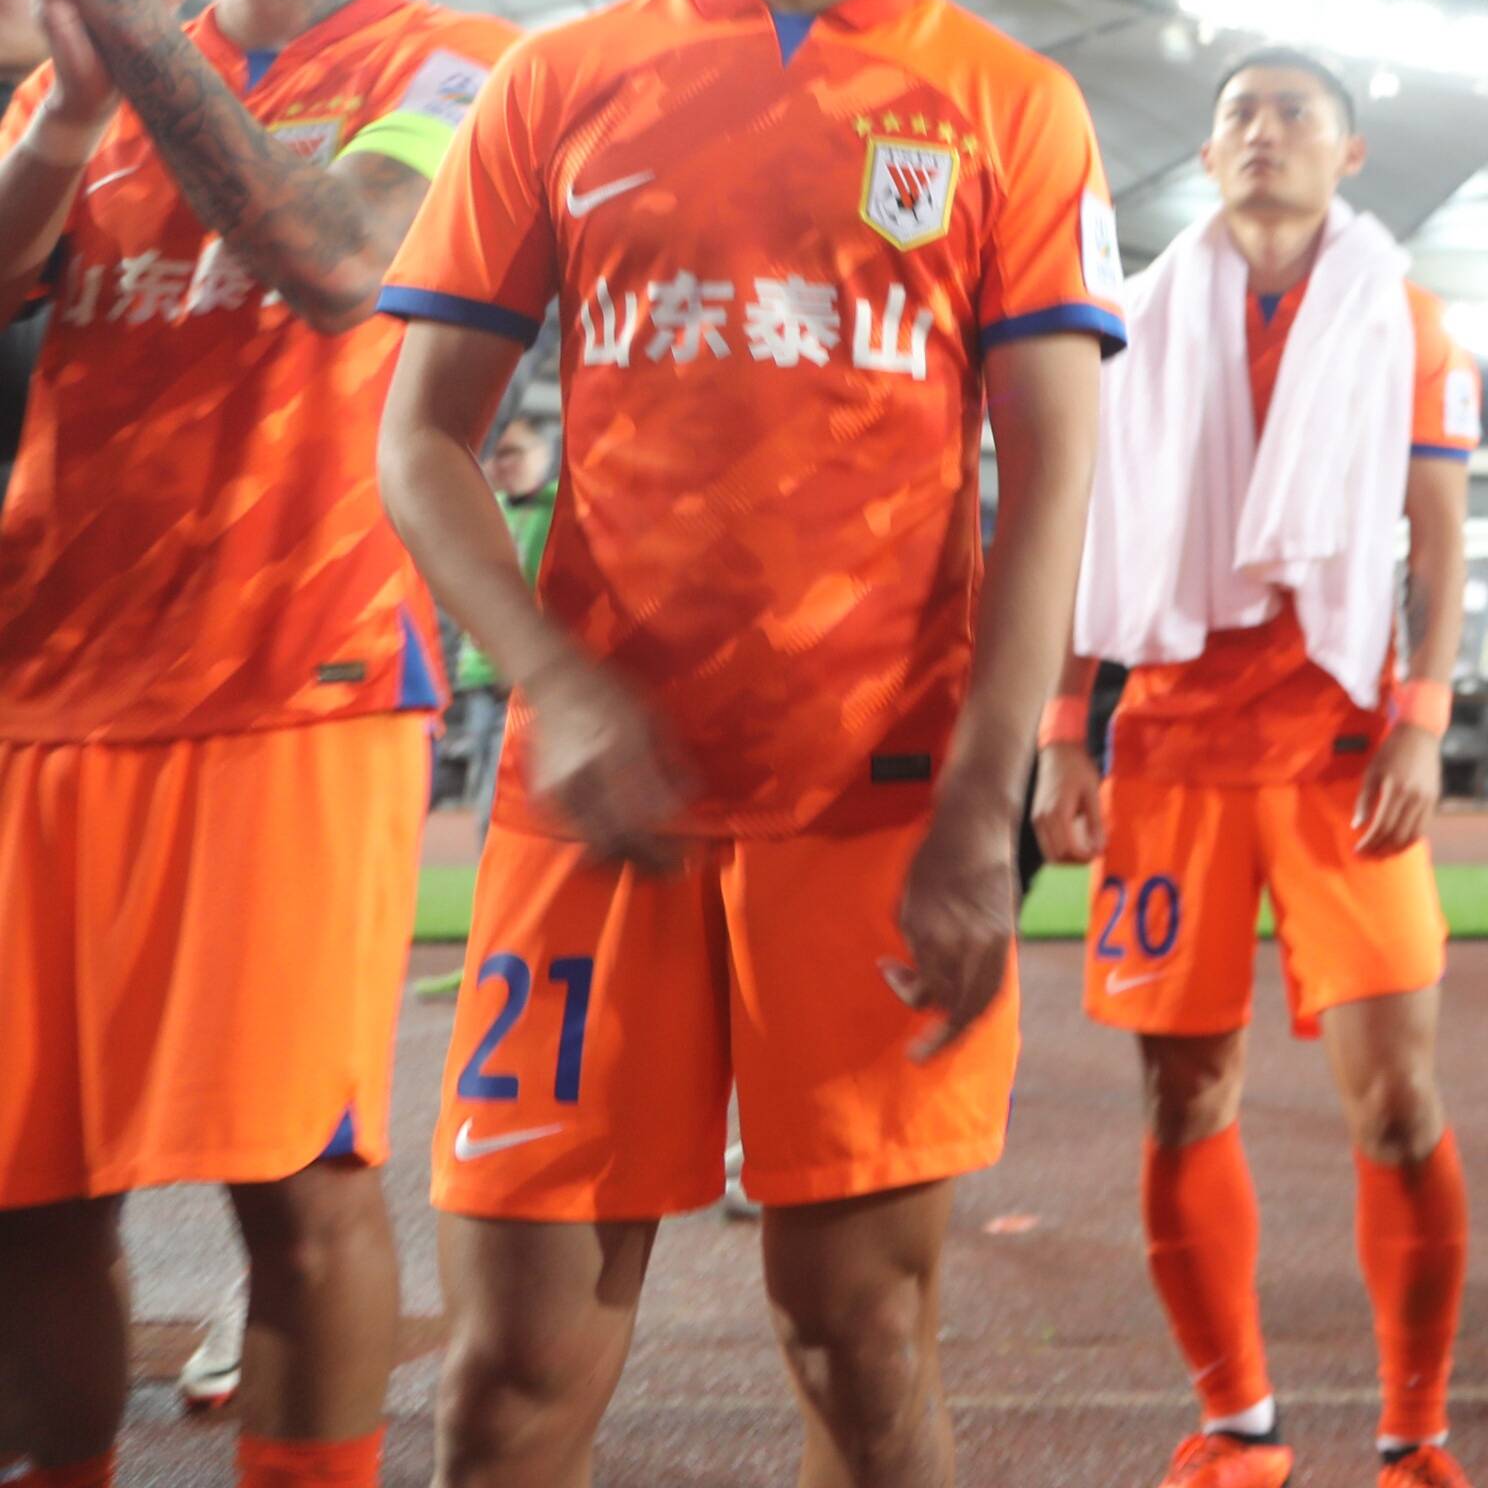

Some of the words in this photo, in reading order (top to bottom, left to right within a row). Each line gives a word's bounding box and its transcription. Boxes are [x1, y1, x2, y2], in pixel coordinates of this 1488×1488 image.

[580, 269, 933, 381] 山东泰山
[1097, 873, 1181, 958] 20
[456, 950, 595, 1106] 21
